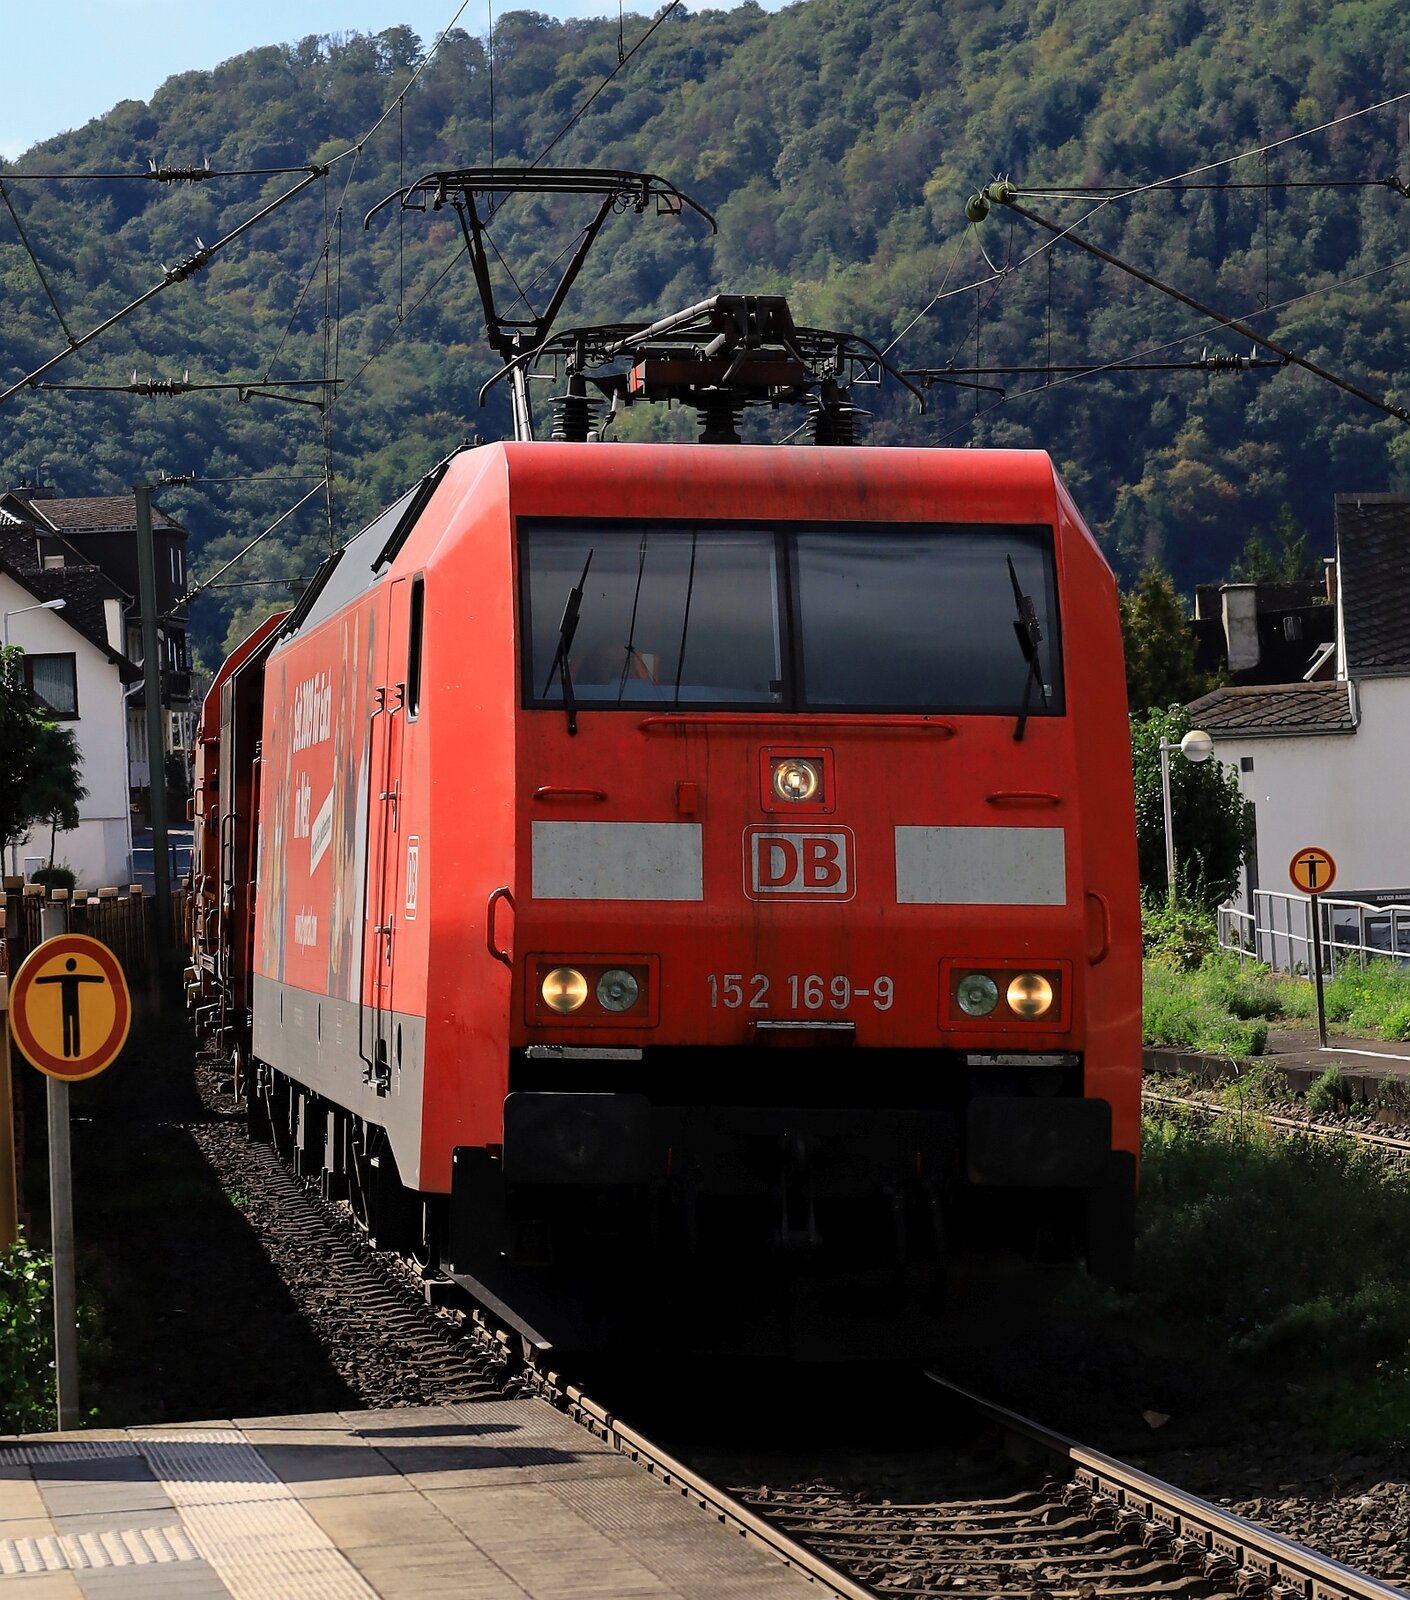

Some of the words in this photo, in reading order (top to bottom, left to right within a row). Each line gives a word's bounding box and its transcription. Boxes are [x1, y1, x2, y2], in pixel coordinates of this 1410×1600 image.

[407, 852, 417, 903] DB
[758, 838, 842, 888] DB
[707, 973, 770, 1008] 152
[787, 974, 894, 1011] 169-9
